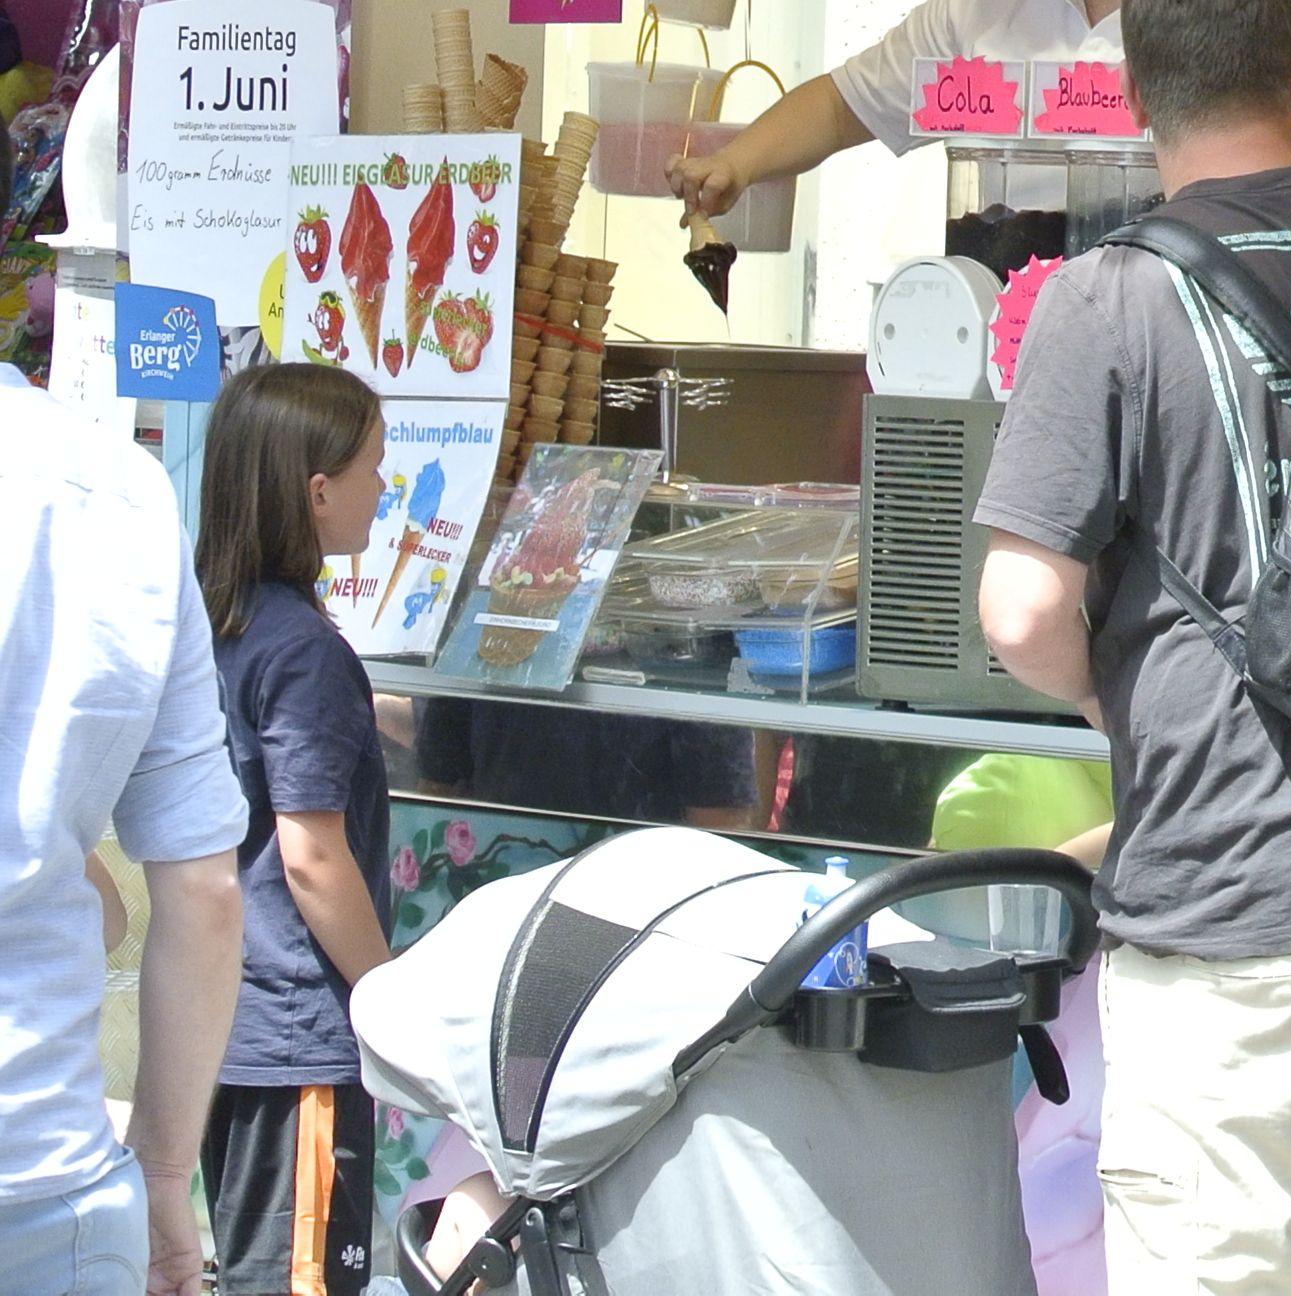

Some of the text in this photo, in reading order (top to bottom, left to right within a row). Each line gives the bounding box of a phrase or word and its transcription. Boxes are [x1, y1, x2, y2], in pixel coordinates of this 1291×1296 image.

[178, 24, 296, 56] Familientag
[180, 63, 288, 111] 1. Juni
[937, 75, 994, 114] Cola
[207, 149, 272, 183] Erdnüsse
[290, 162, 512, 186] NEU!!! EISGLASUR ERDBEER
[130, 205, 282, 237] Eis mit Schokoglasur
[140, 330, 175, 343] Erlanger
[130, 342, 183, 371] Berg
[427, 517, 463, 541] NEU!!!
[330, 578, 378, 598] NEU!!!
